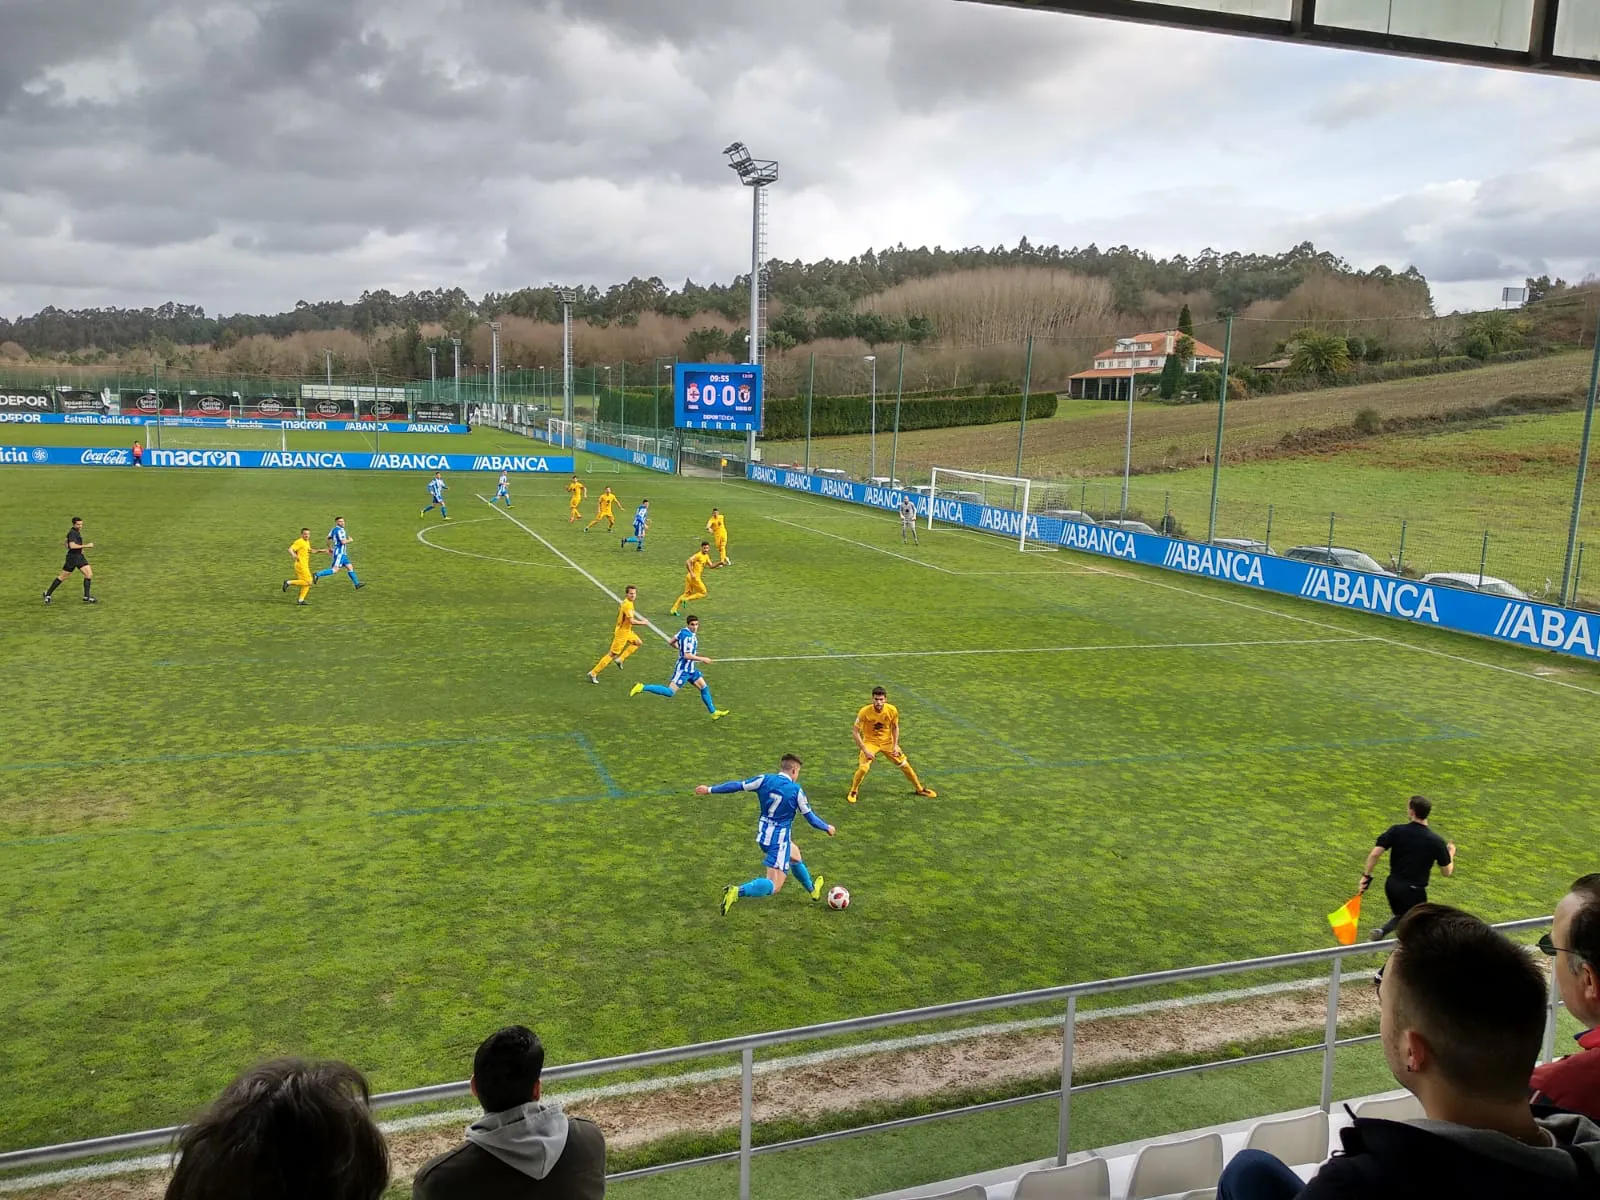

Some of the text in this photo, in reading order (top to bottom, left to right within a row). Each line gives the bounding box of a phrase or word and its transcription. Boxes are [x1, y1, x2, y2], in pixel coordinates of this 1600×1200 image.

[0, 395, 48, 406] DEPOR
[64, 415, 131, 424] Estrella Galicia
[282, 420, 327, 430] macron
[412, 424, 450, 433] ABANCA
[151, 450, 241, 467] macron
[268, 452, 346, 468] ABANCA
[377, 454, 451, 470] ABANCA
[479, 456, 549, 471] ABANCA
[754, 466, 777, 483] ABANCA
[787, 473, 811, 490] ABANCA
[823, 480, 854, 499] ABANCA
[868, 487, 902, 511] ABANCA
[918, 498, 963, 522] AANCA
[1066, 524, 1136, 559] ABANCA
[1172, 543, 1265, 586] ABANCA
[1312, 569, 1440, 623] ABANCA
[1510, 606, 1600, 658] ABA
[769, 793, 782, 817] 7
